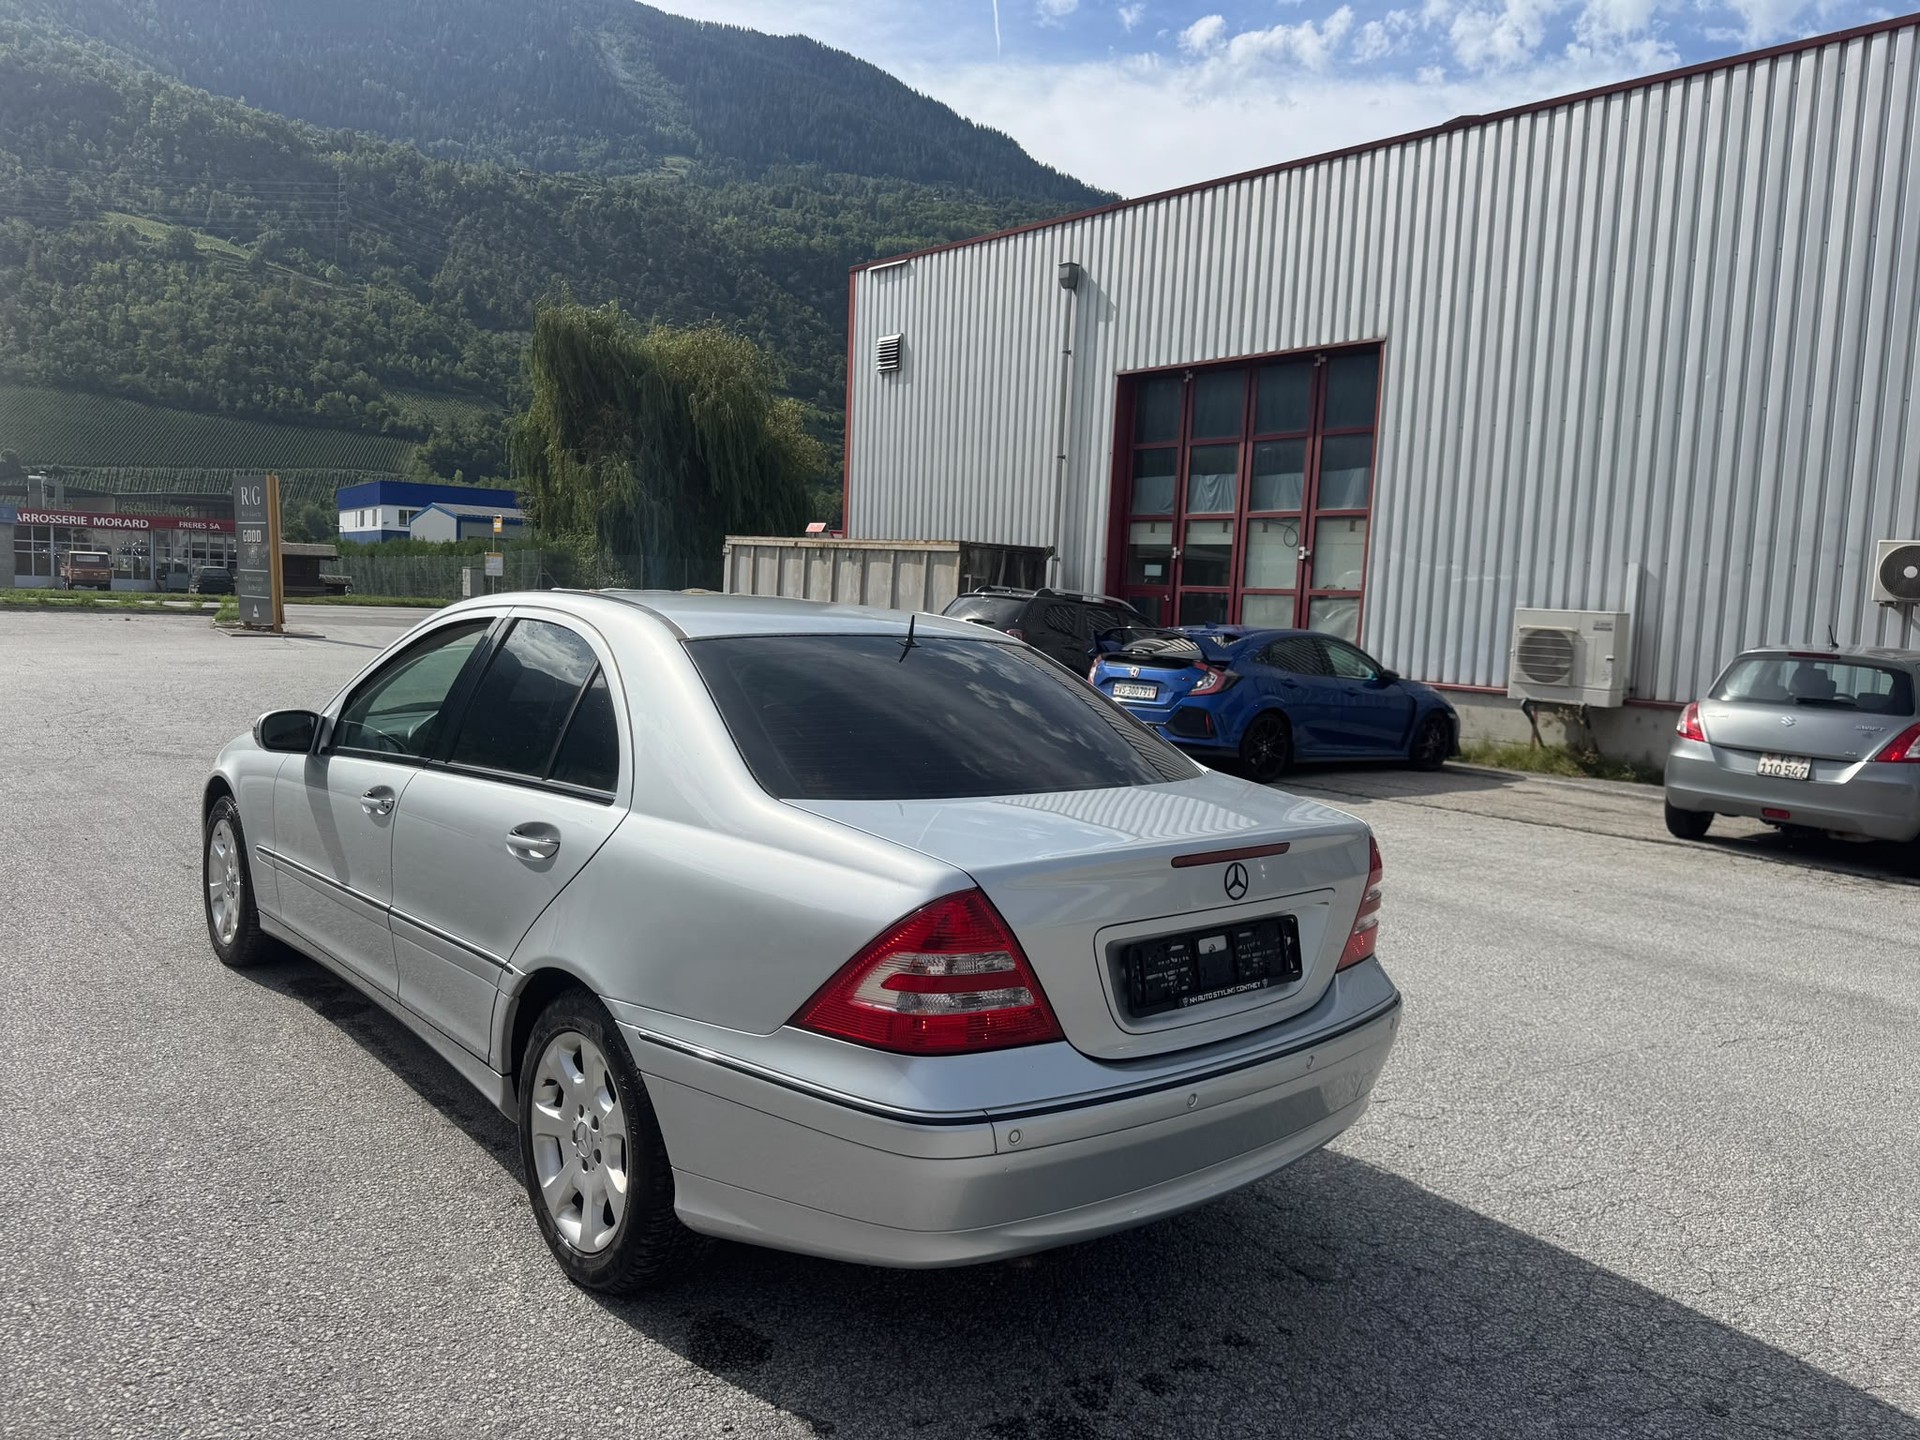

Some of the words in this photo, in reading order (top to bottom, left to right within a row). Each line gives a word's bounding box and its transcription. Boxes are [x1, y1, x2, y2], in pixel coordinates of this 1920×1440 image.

[93, 516, 149, 529] MORARD
[209, 522, 220, 530] SA
[242, 529, 262, 543] GOOD
[1780, 754, 1792, 763] VS
[1761, 762, 1782, 775] 110
[1784, 765, 1807, 779] 547
[1198, 992, 1213, 1001] AUTO
